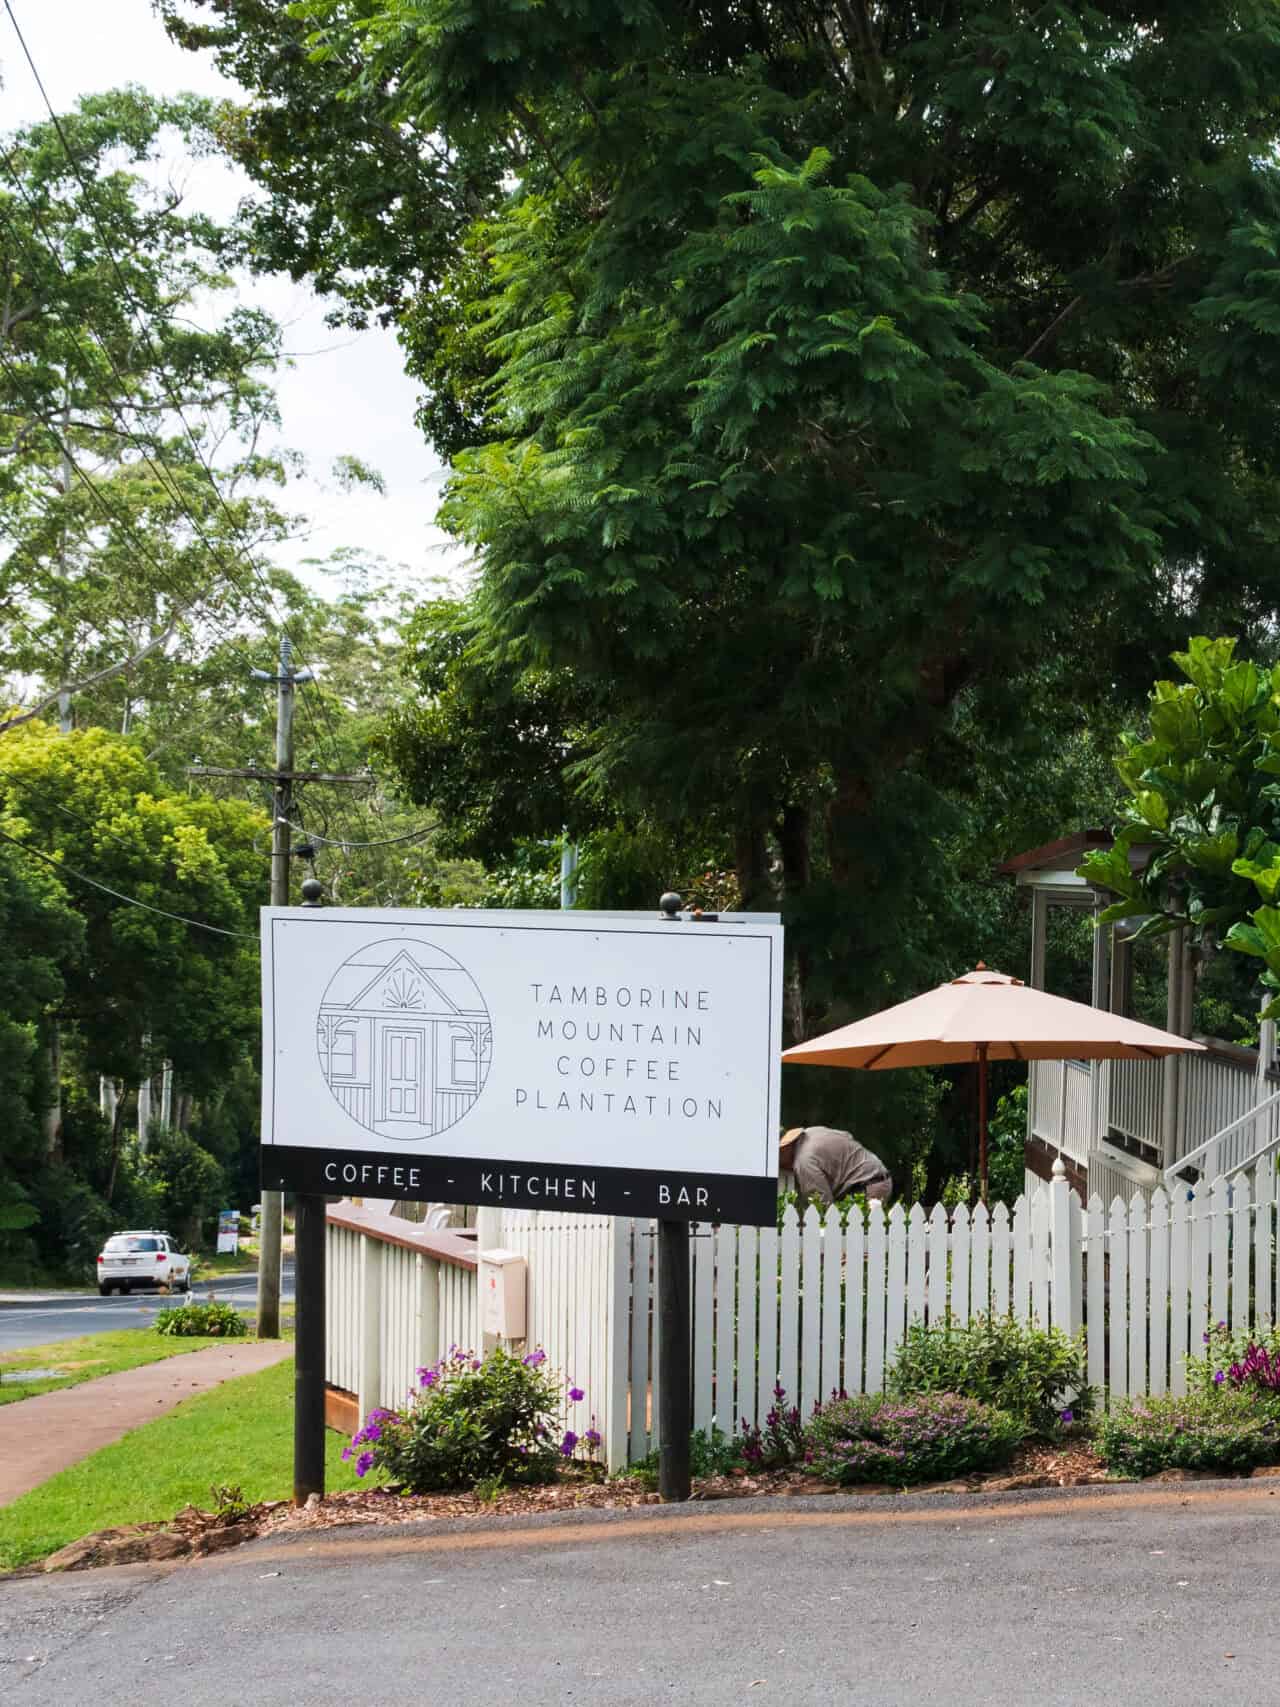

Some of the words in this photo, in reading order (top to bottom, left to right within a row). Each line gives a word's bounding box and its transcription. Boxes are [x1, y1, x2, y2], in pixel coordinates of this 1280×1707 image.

[530, 983, 711, 1011] TAMBORINE
[537, 1019, 702, 1047] MOUNTAIN
[556, 1055, 682, 1081] COFFEE
[515, 1087, 723, 1120] PLANTATION
[324, 1162, 422, 1187] COFFEE
[481, 1173, 597, 1199] KITCHEN
[659, 1184, 710, 1207] BAR
